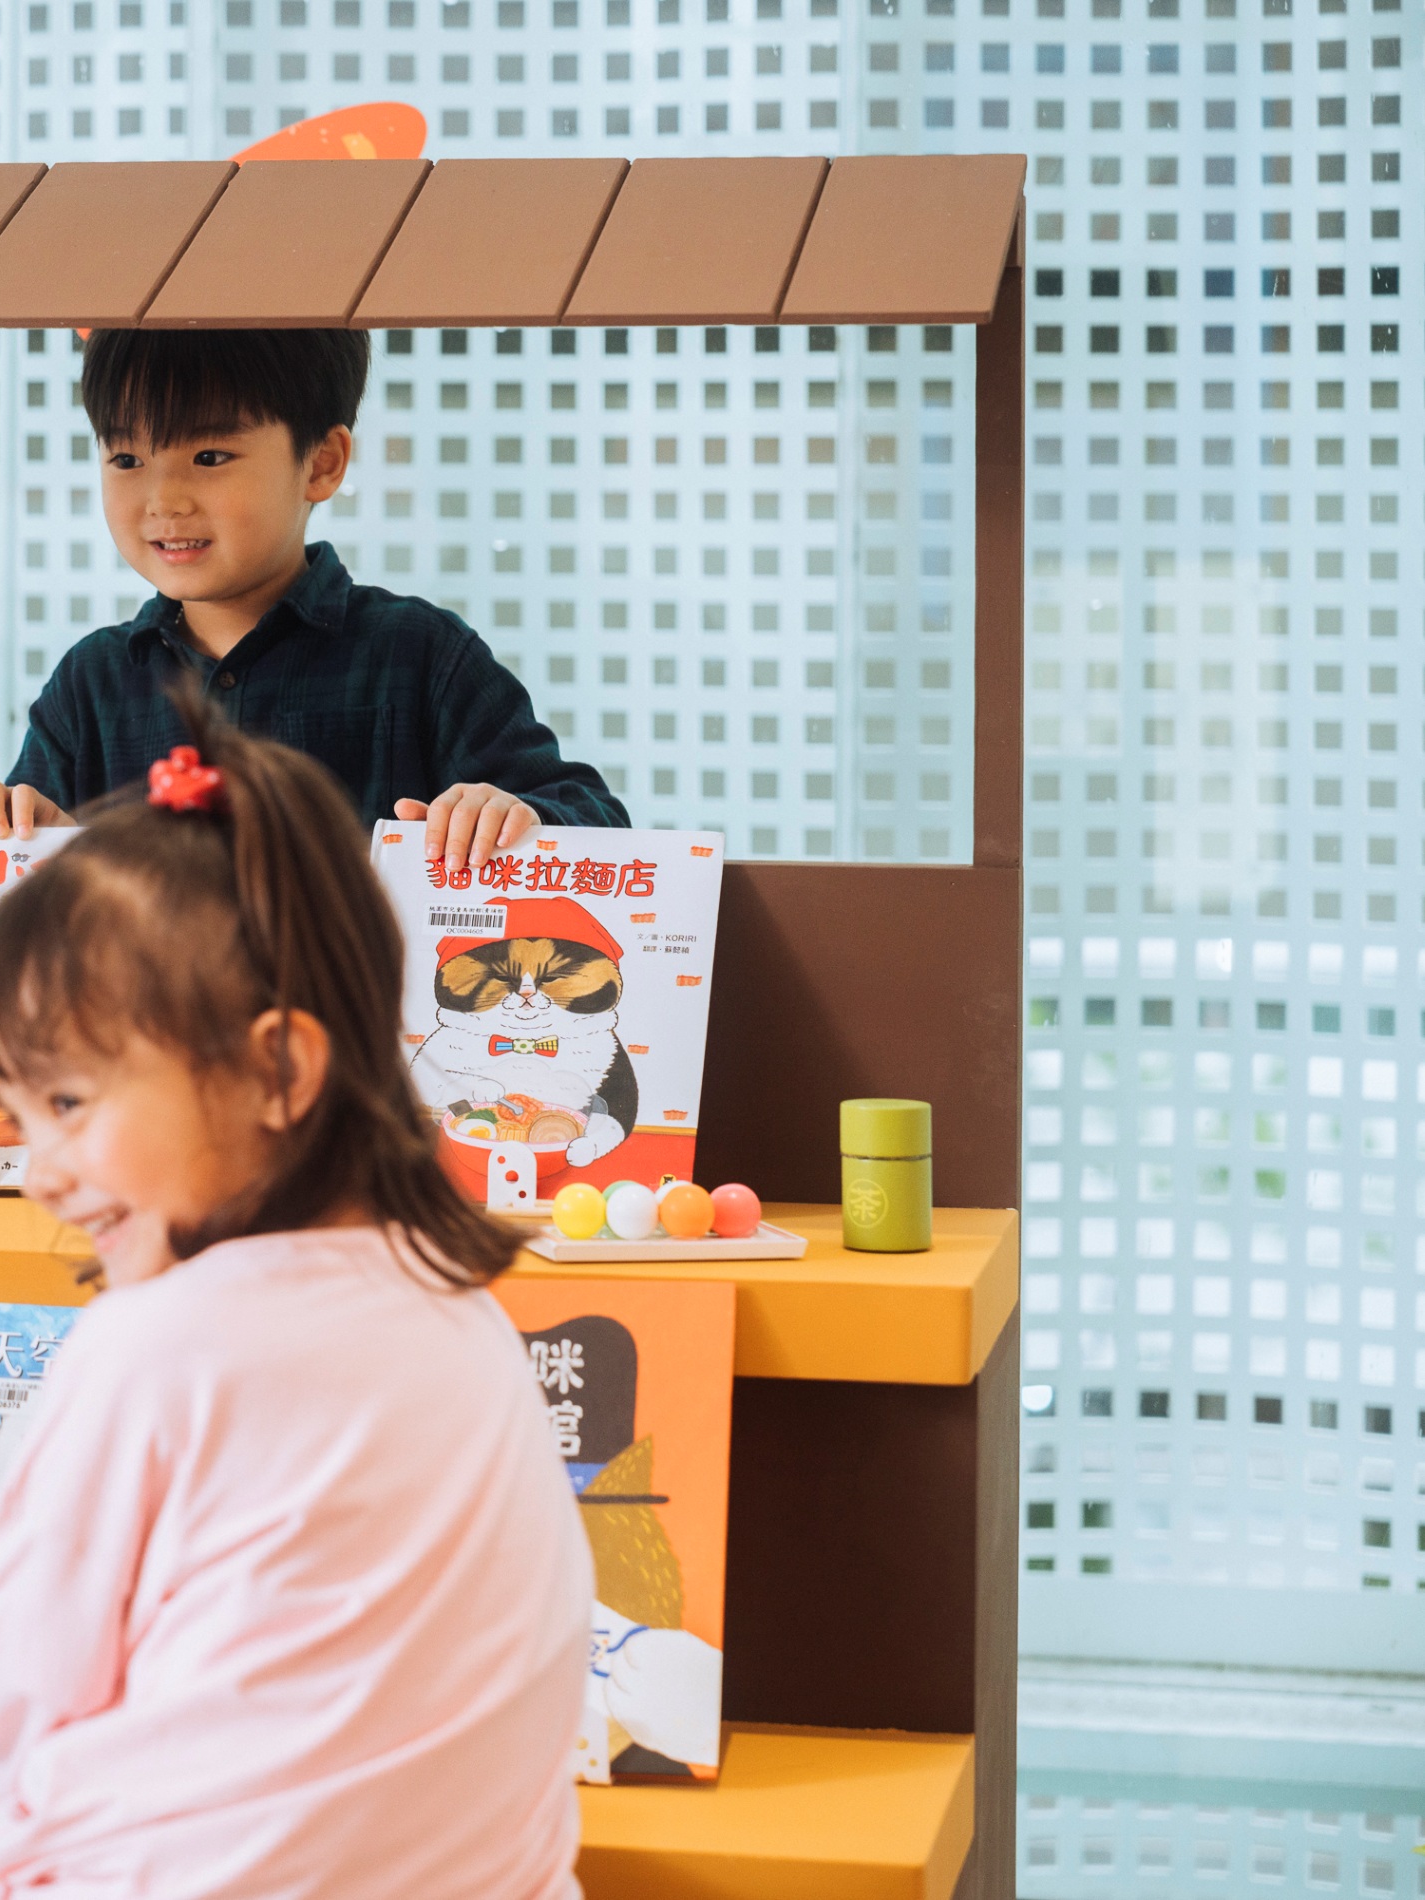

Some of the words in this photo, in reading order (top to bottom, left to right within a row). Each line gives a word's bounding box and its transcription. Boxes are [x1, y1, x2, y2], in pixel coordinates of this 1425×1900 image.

[425, 855, 658, 898] 貓咪拉麵店
[850, 1187, 881, 1221] 茶
